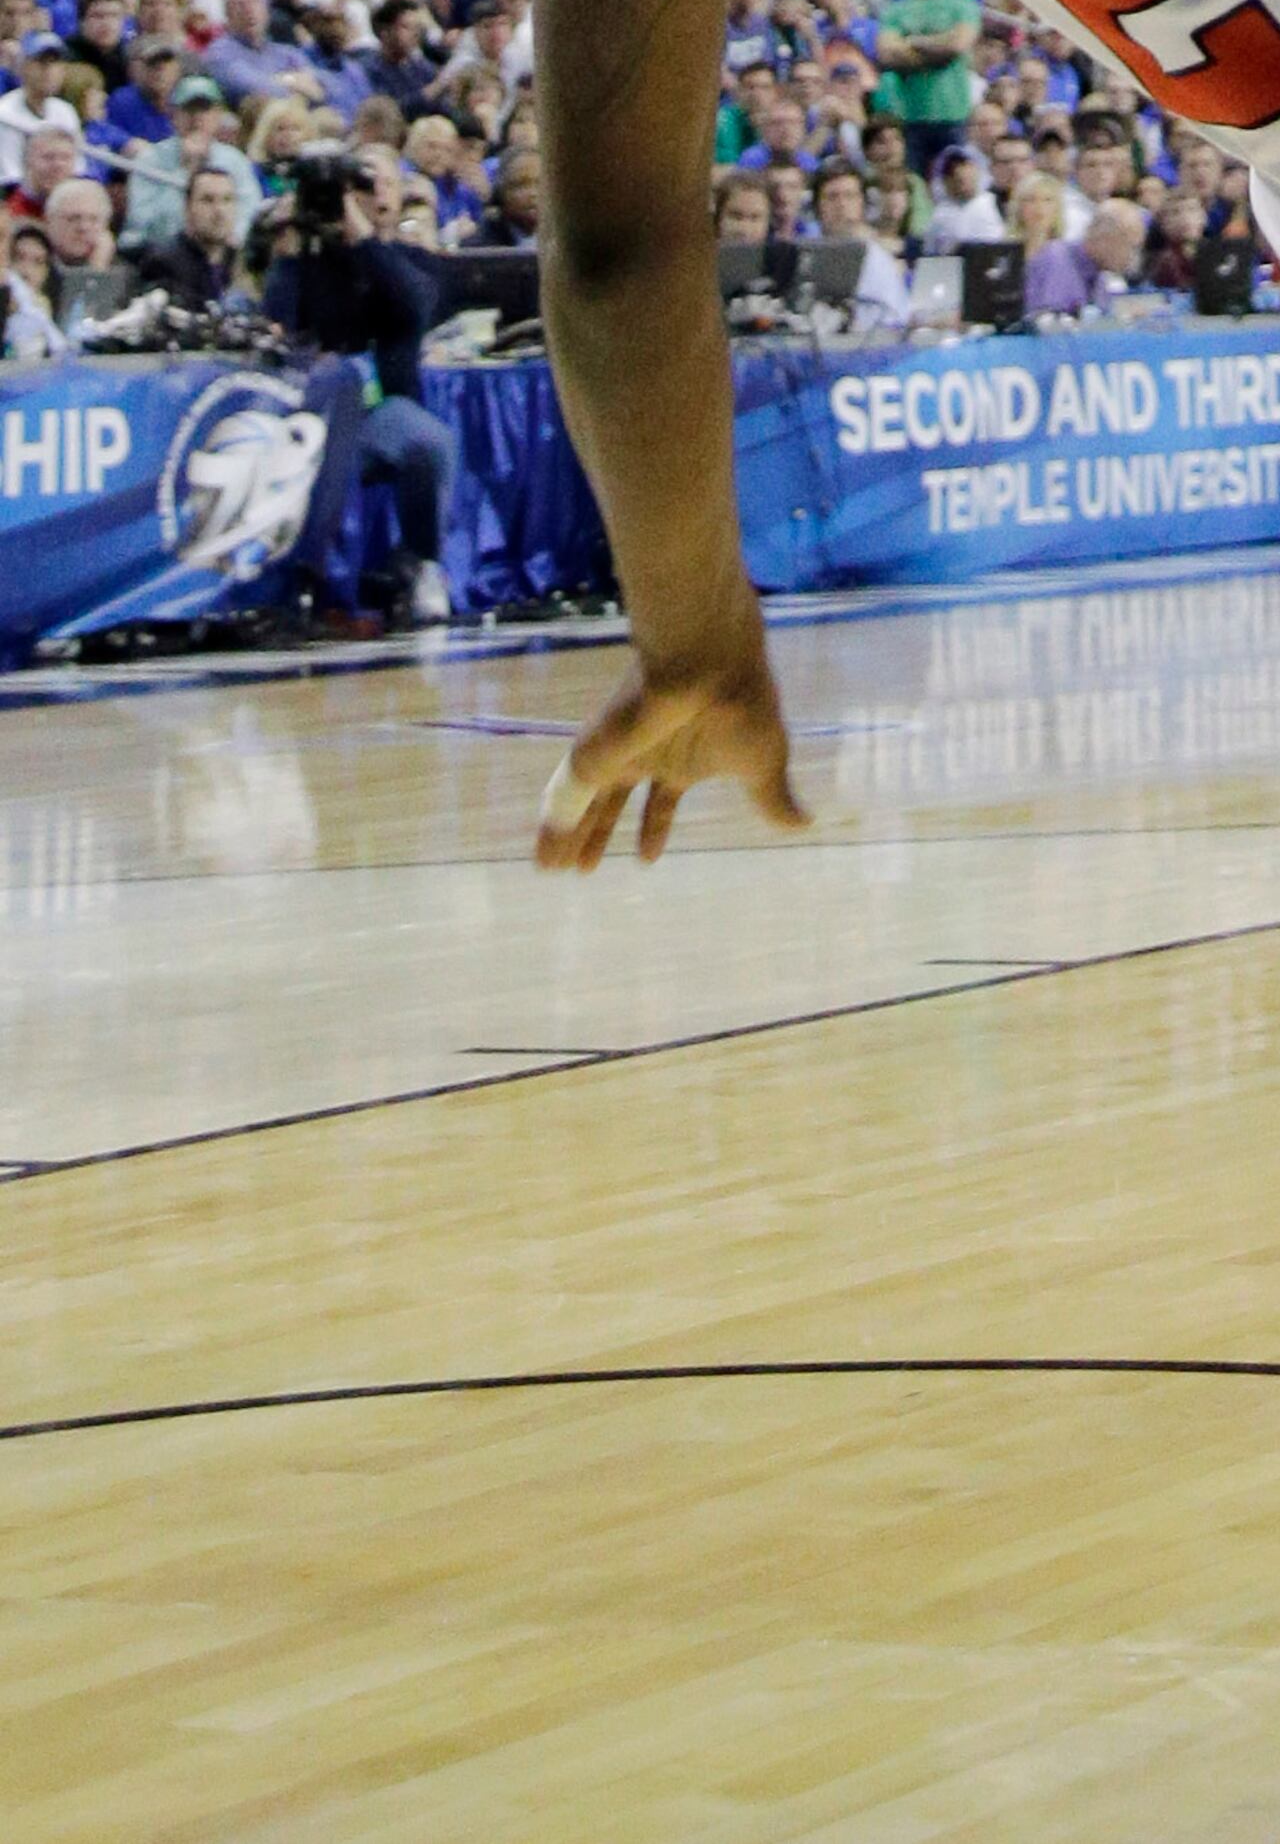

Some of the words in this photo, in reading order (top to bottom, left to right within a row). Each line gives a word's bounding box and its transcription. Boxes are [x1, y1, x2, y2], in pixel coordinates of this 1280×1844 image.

[0, 406, 130, 499] HIP
[830, 365, 1042, 454] SECOND
[1046, 361, 1159, 436] AND
[921, 460, 1071, 534] TEMPLE
